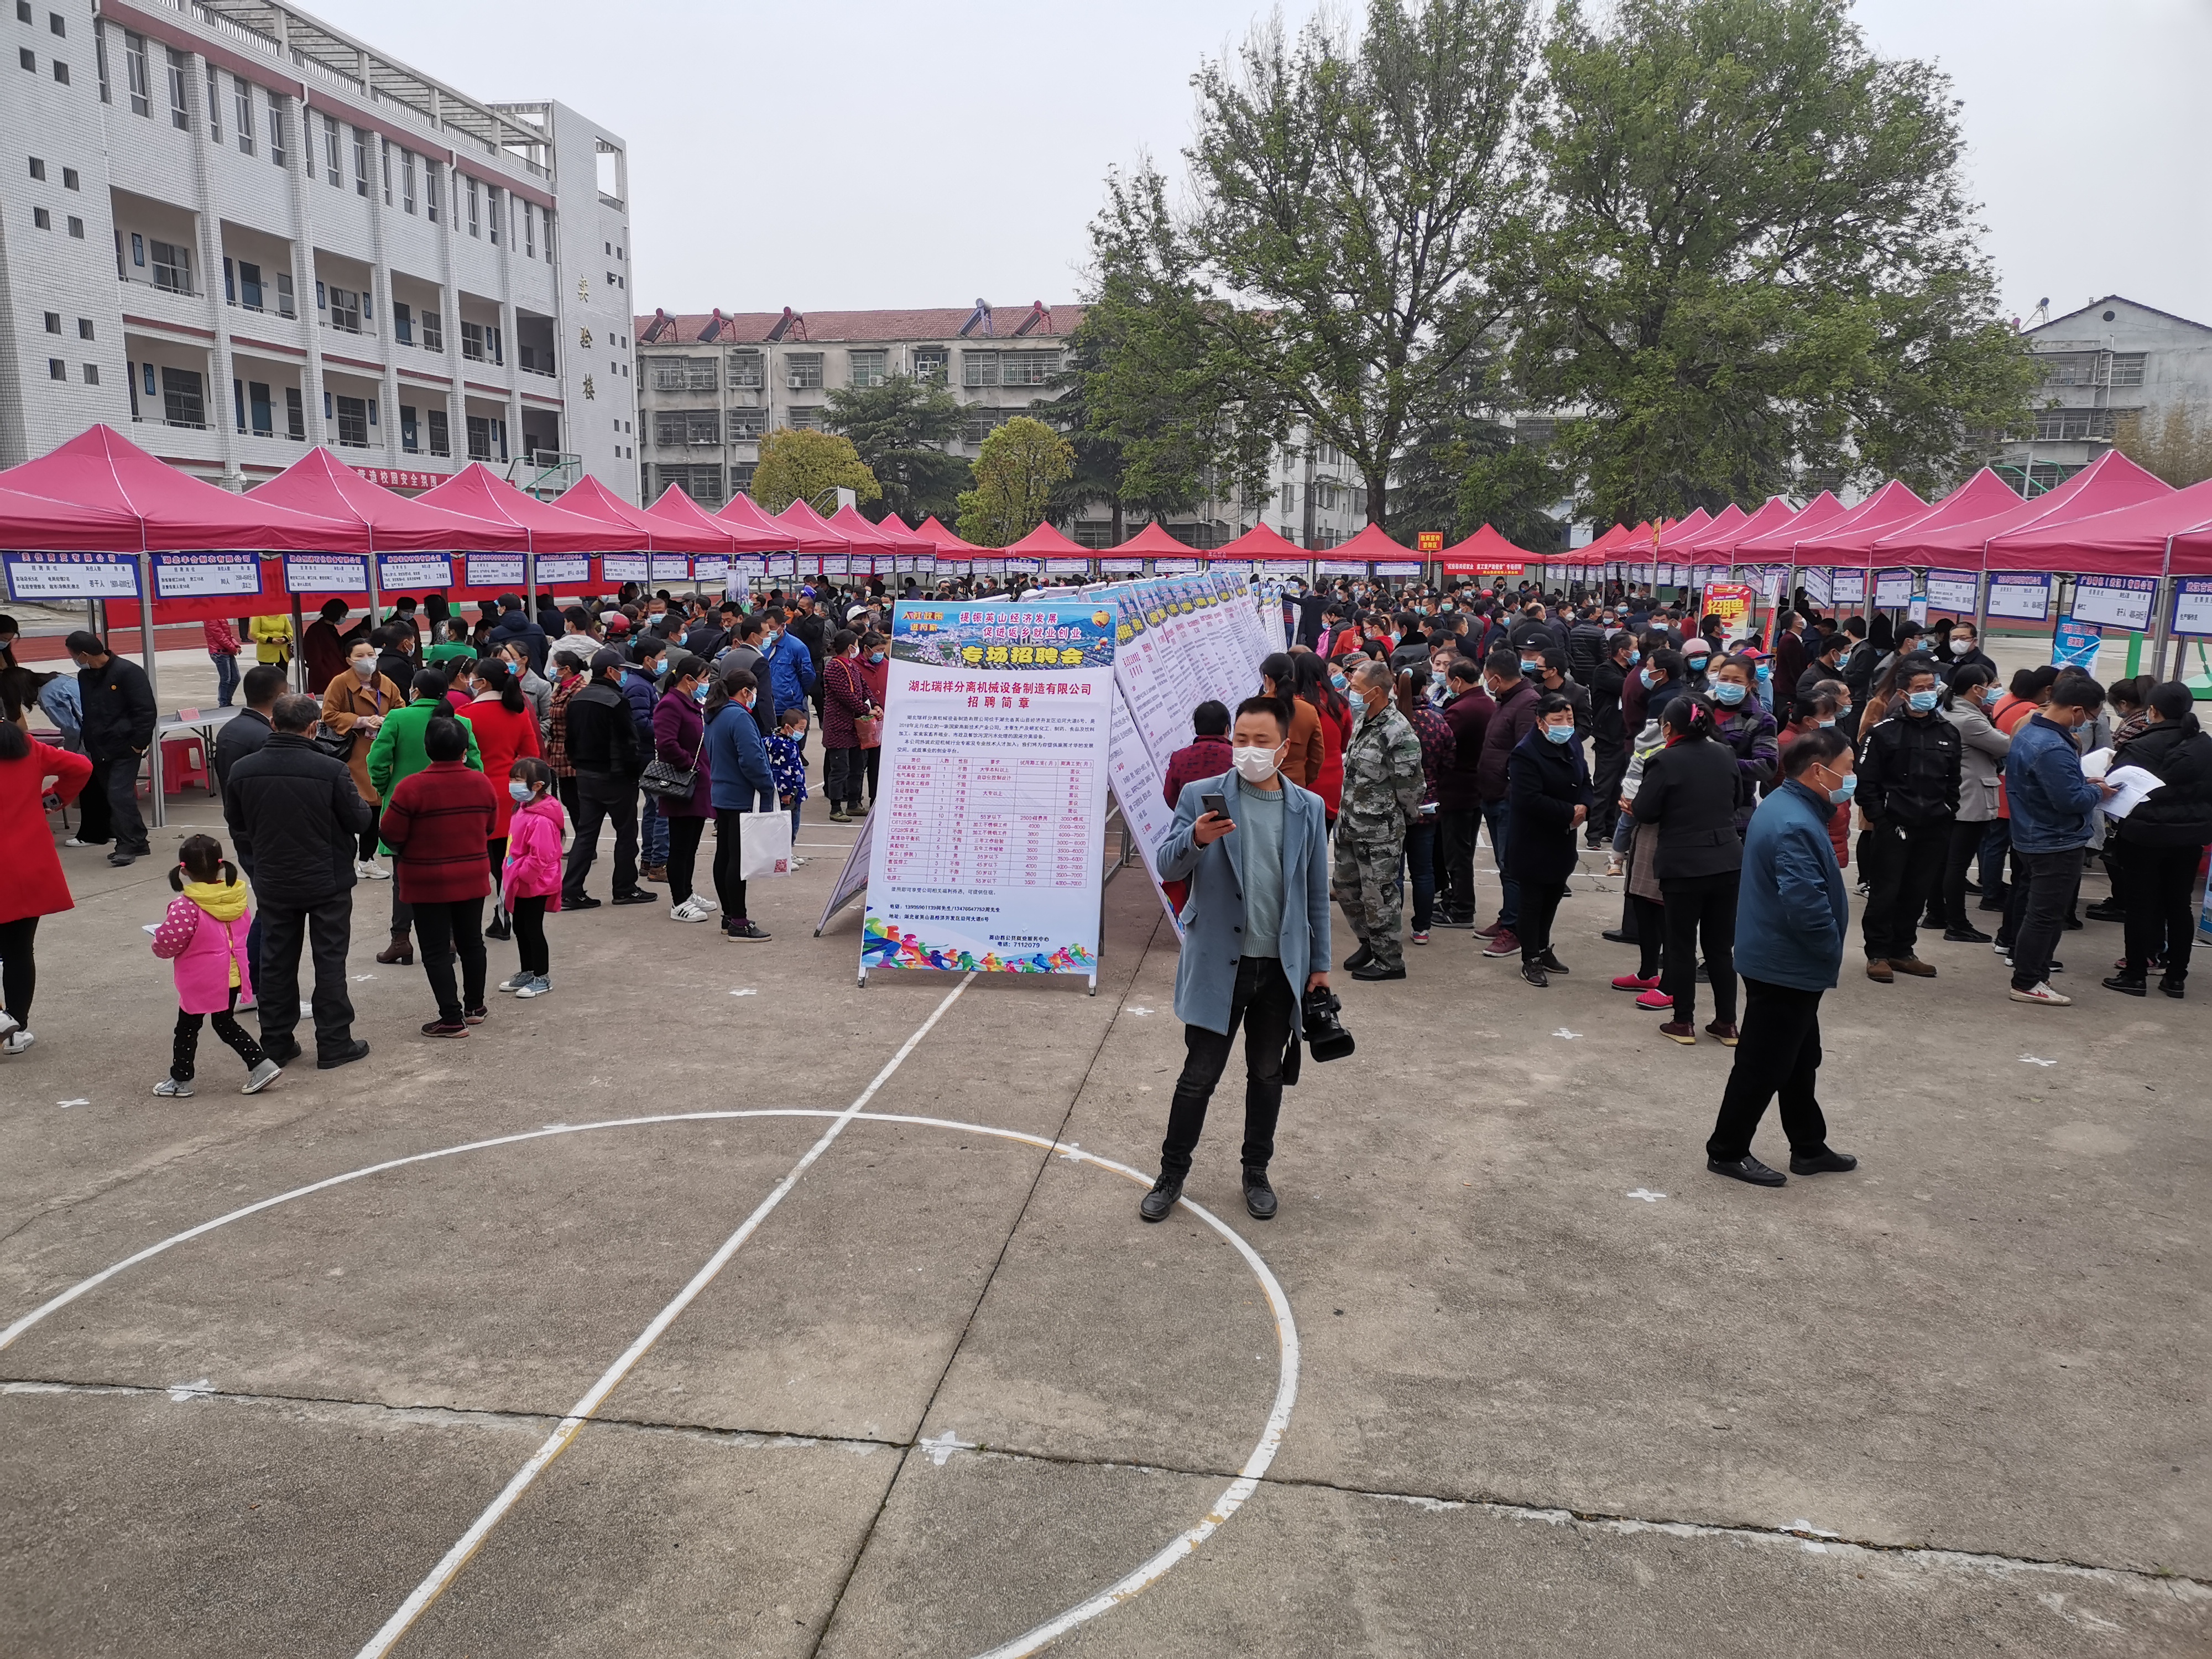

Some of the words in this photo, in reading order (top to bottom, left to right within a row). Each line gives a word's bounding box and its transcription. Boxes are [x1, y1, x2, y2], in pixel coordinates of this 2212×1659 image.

[1707, 598, 1744, 618] 招聘
[902, 612, 943, 620] 人社政策
[959, 612, 1058, 624] 提振英山经济发展
[983, 627, 1082, 640] 促进返乡就业创业
[961, 645, 1084, 664] 专场招聘会
[909, 680, 1092, 696] 湖北瑞祥分离机械设备制造有限公司
[968, 696, 1030, 709] 招聘简章
